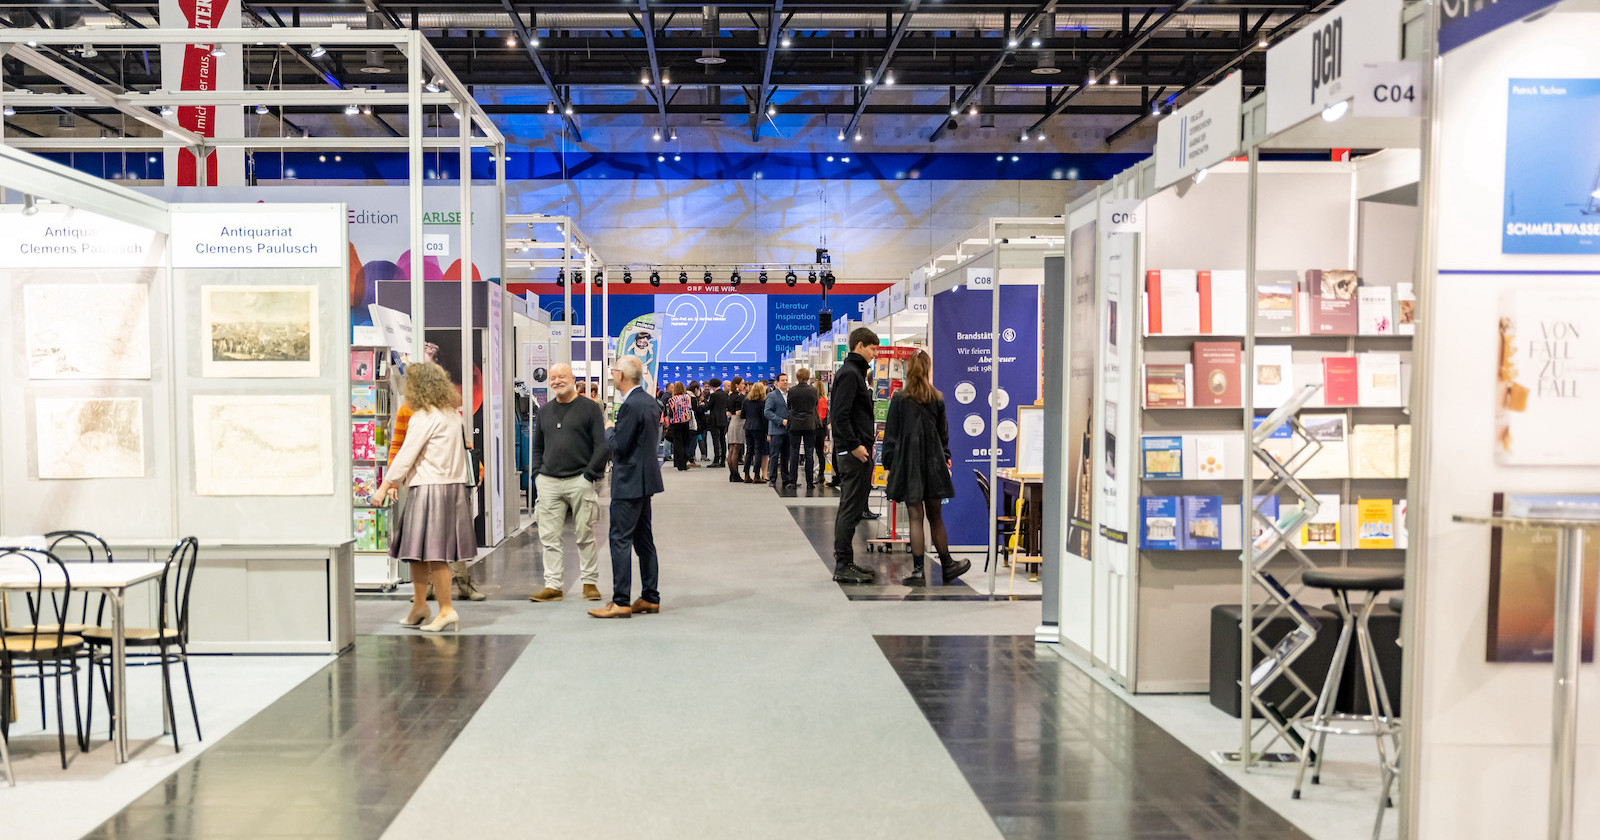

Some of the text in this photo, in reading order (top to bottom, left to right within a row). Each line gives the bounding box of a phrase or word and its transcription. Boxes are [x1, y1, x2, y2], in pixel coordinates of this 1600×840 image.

[199, 54, 211, 78] raus,
[1311, 16, 1343, 105] pen
[1374, 84, 1415, 103] C04
[423, 212, 474, 223] ARLSE
[1112, 213, 1137, 224] C06
[220, 226, 292, 239] Antiquariat
[20, 243, 77, 254] Clemens
[195, 243, 318, 254] Clemens Paulusch
[426, 243, 444, 251] C03
[775, 313, 816, 321] Inspiration
[665, 293, 757, 363] 22
[775, 323, 815, 331] Austausch
[1540, 321, 1579, 340] VON
[956, 332, 1000, 340] Brandstättr
[775, 344, 794, 352] Bildu
[971, 347, 991, 355] feiern
